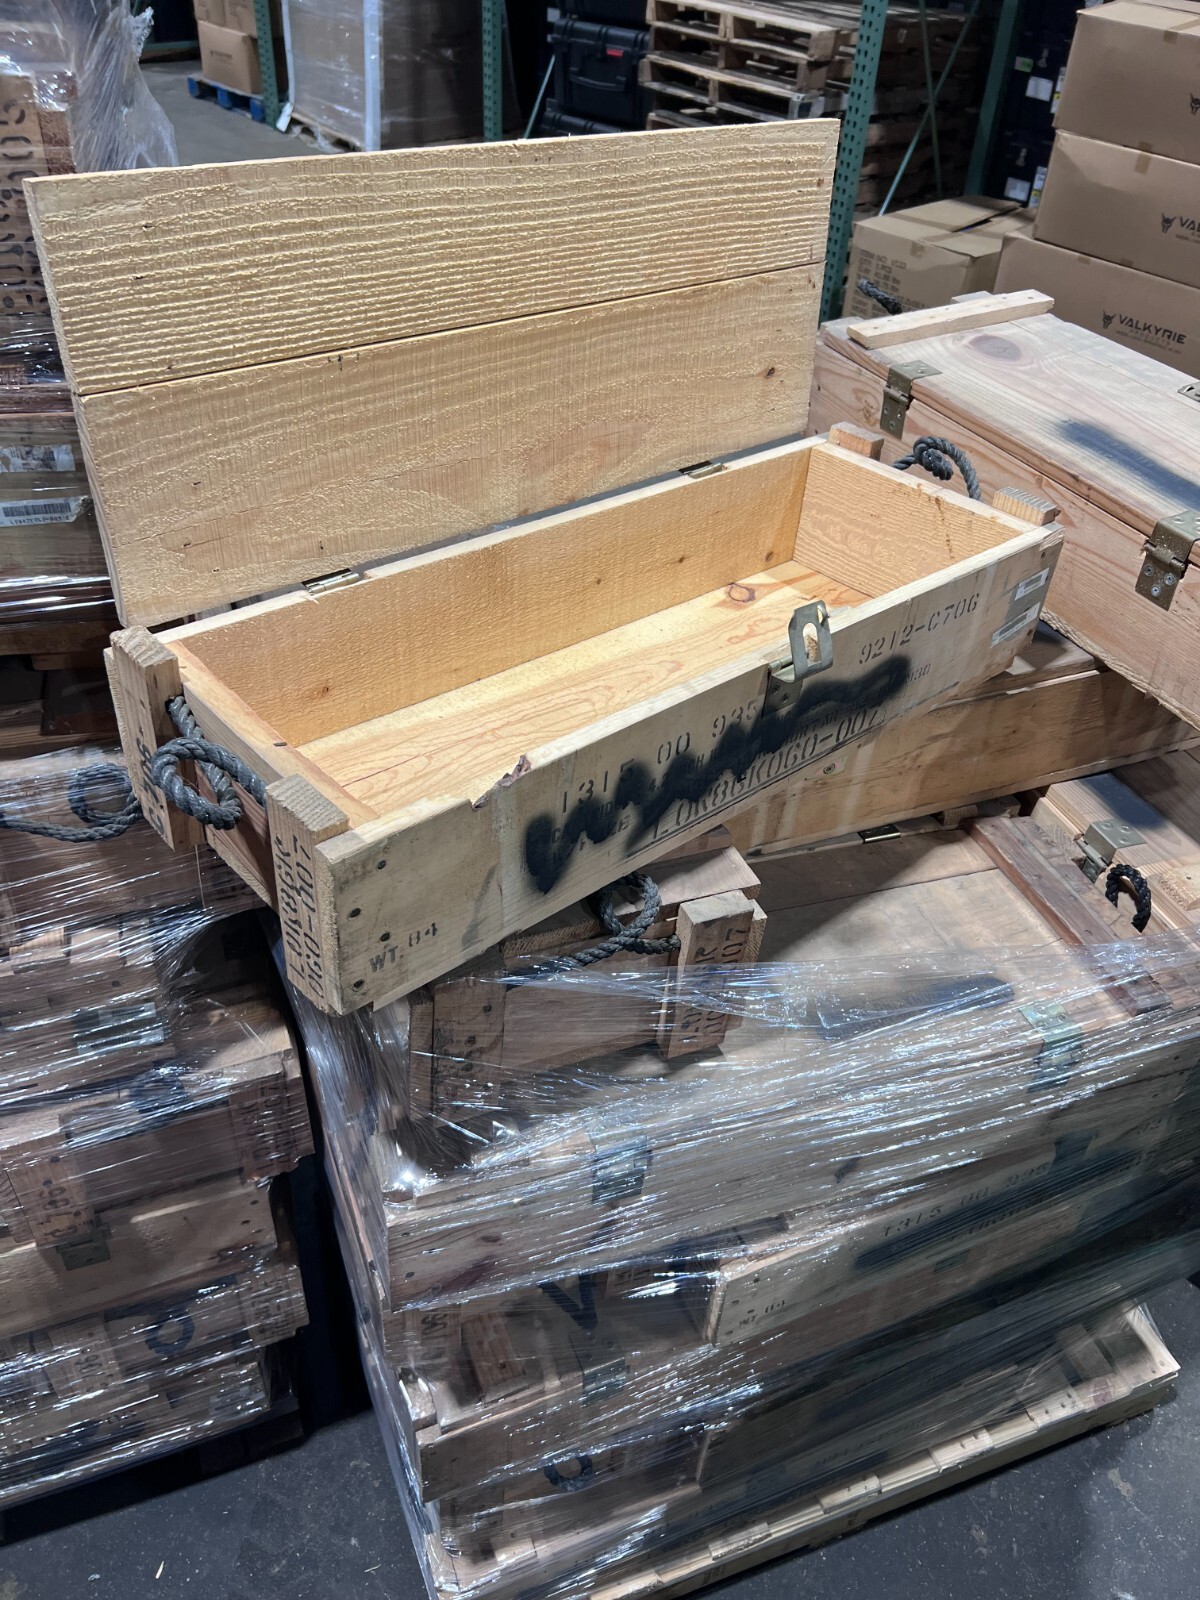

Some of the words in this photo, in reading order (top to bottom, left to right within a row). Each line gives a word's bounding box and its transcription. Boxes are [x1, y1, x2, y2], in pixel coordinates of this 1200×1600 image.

[1118, 313, 1188, 345] VALKYRIE
[656, 731, 692, 765] 00
[858, 592, 979, 666] 9212-C706
